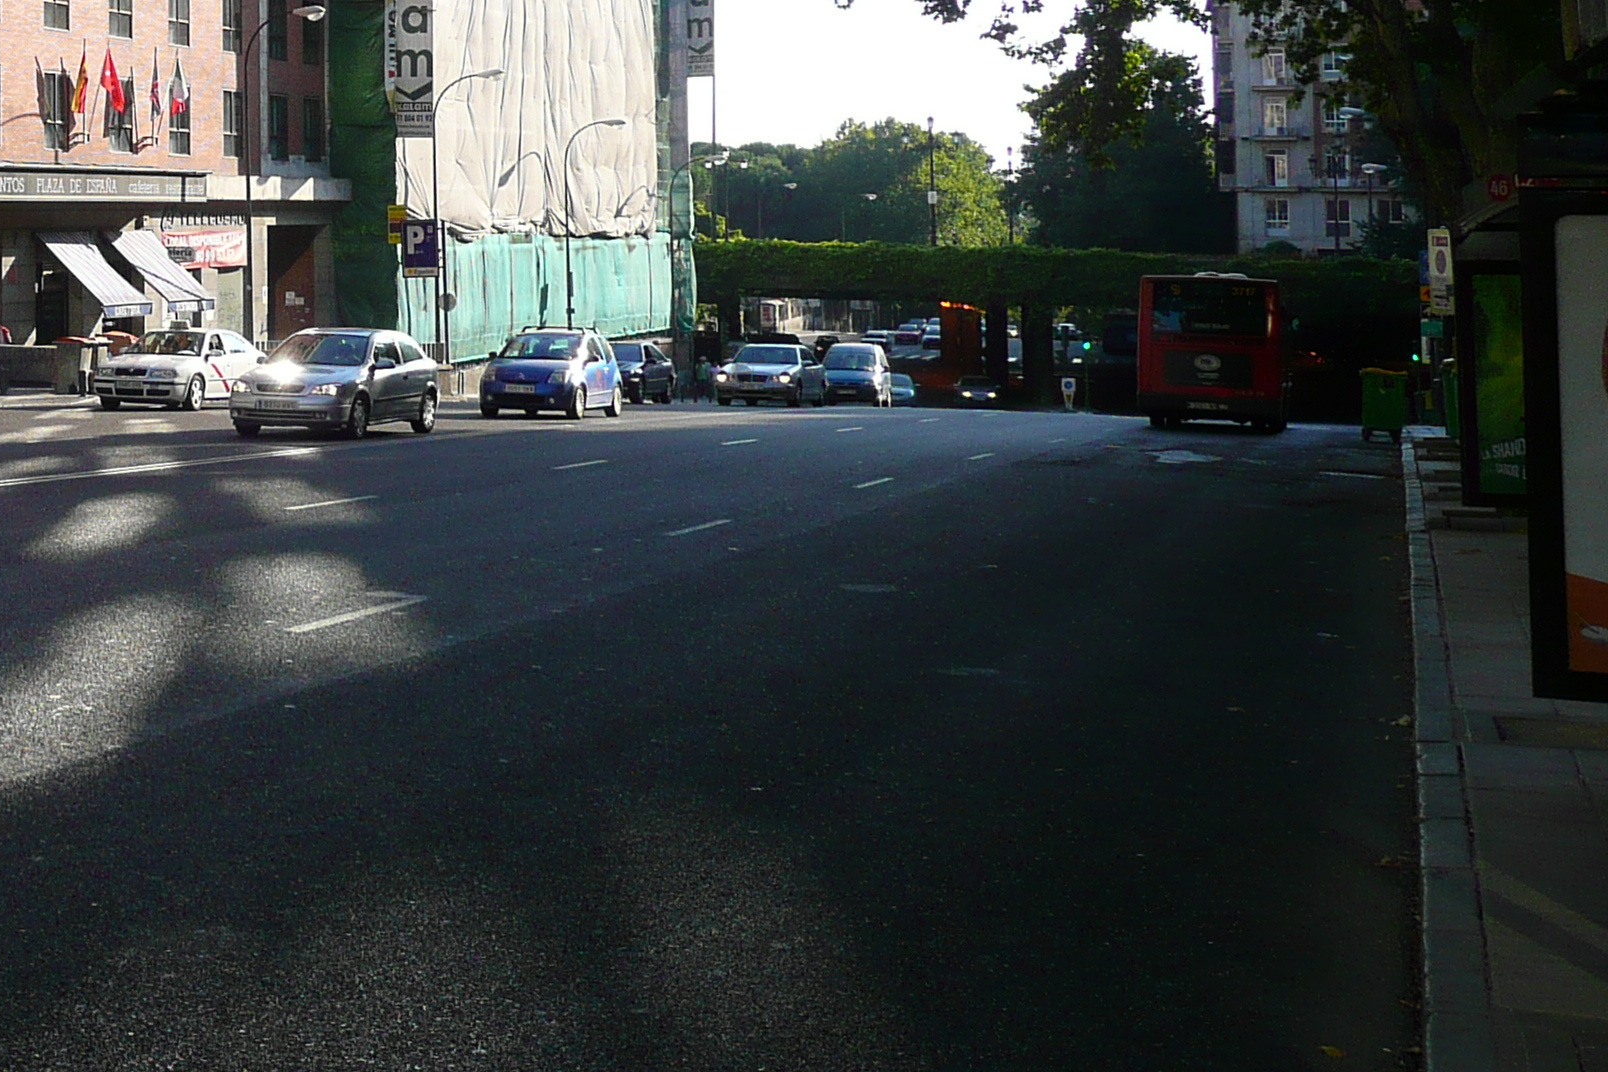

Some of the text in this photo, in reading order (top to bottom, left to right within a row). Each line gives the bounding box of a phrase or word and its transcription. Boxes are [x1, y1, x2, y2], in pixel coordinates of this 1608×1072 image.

[36, 177, 65, 195] PLAZA
[69, 177, 82, 194] DE
[85, 175, 117, 195] ESPAÑA
[1490, 179, 1509, 197] 46
[406, 225, 425, 255] P
